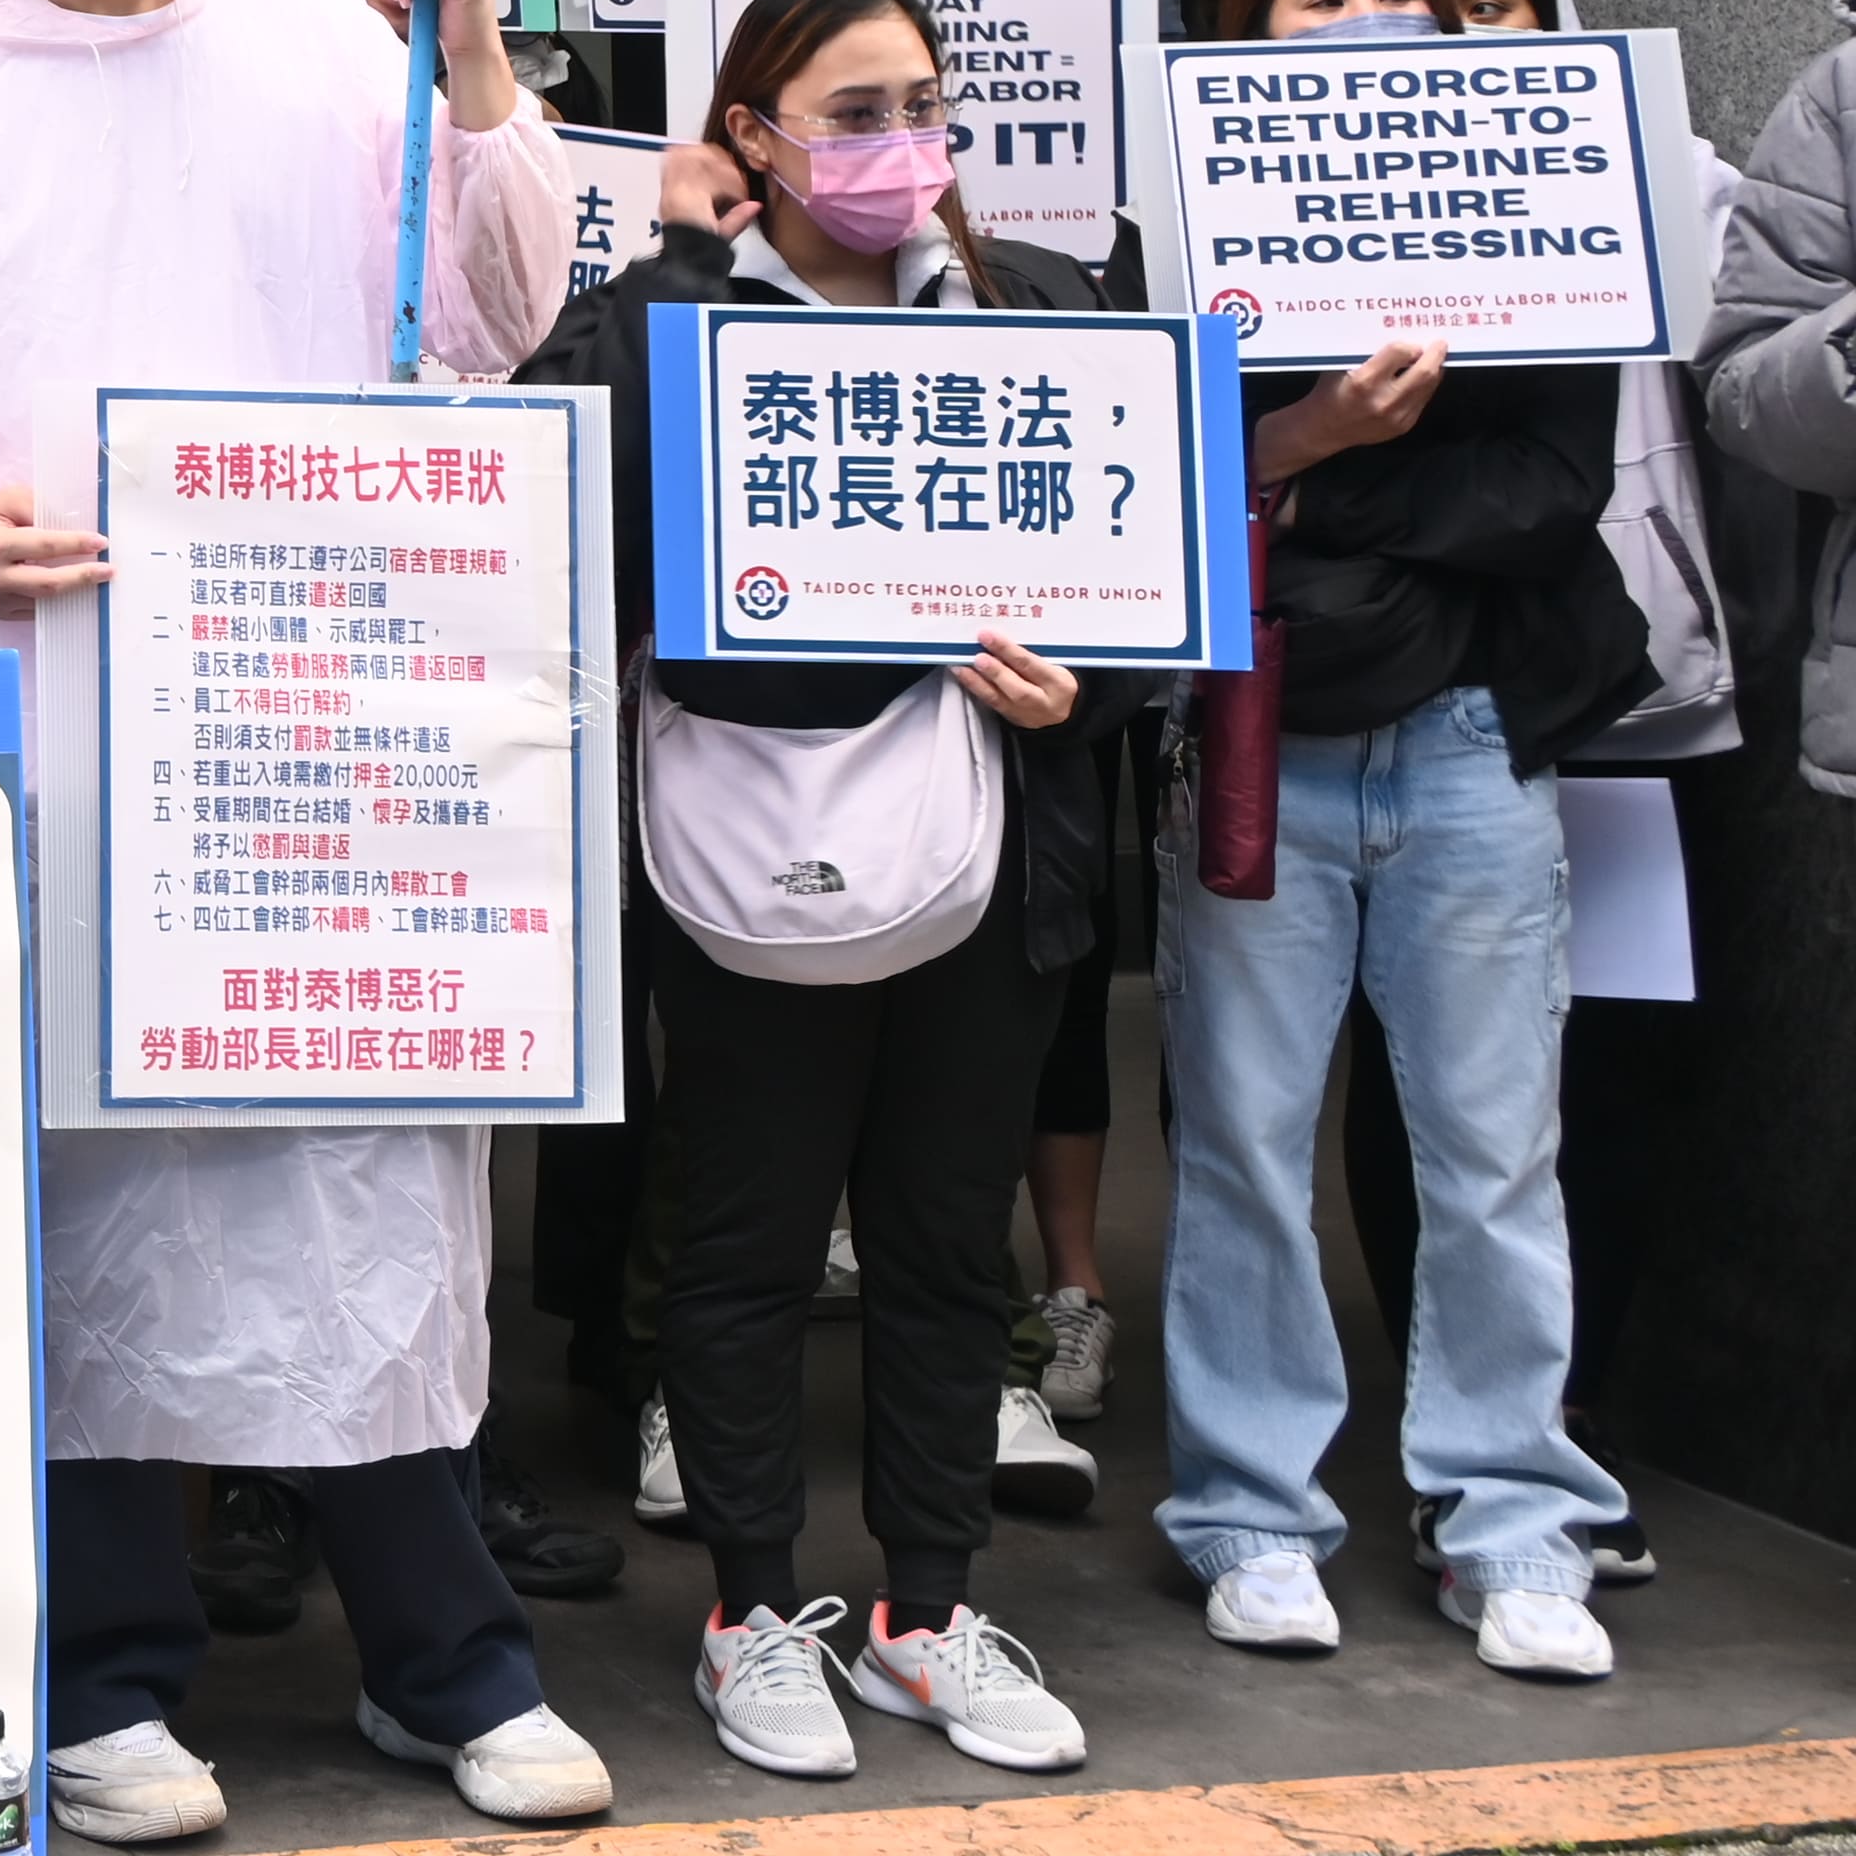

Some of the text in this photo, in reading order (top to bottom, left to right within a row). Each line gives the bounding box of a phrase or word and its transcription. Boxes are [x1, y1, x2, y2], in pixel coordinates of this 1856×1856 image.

[1195, 64, 1599, 106] END FORCED
[1212, 104, 1593, 145] RETURN-TO-
[994, 121, 1086, 166] IT!
[1205, 144, 1610, 186] PHILIPPINES
[980, 208, 1097, 223] LABOR UNION
[1294, 188, 1530, 223] REHIRE
[1212, 225, 1623, 267] PROCESSING
[1275, 291, 1629, 313] TAIDOC TECHNOLOGY LABOR UNION
[1382, 311, 1514, 329] 泰博科技企業工會
[742, 370, 1126, 449] 泰博違法，
[174, 442, 507, 505] 泰博科技七大罪狀
[742, 453, 1136, 537] 部長在哪？
[190, 579, 387, 609] 違反者可直接遣送回國
[802, 581, 1163, 601] TAIDOC TECHNOLOGY LABOR UNION
[910, 601, 1044, 619] 泰博科技企業工會
[192, 651, 486, 683] 違反者處勞動服務兩個月遣返回國
[193, 725, 452, 753] 否則須支付罰款並無條件遣返
[193, 832, 351, 860] 將予以懲罰與遣返
[771, 872, 819, 886] NORTH
[789, 861, 818, 872] THE
[785, 883, 822, 896] FACE
[222, 967, 465, 1013] 面對泰博惡行
[140, 1026, 535, 1073] 勞動部長到底在哪裡？
